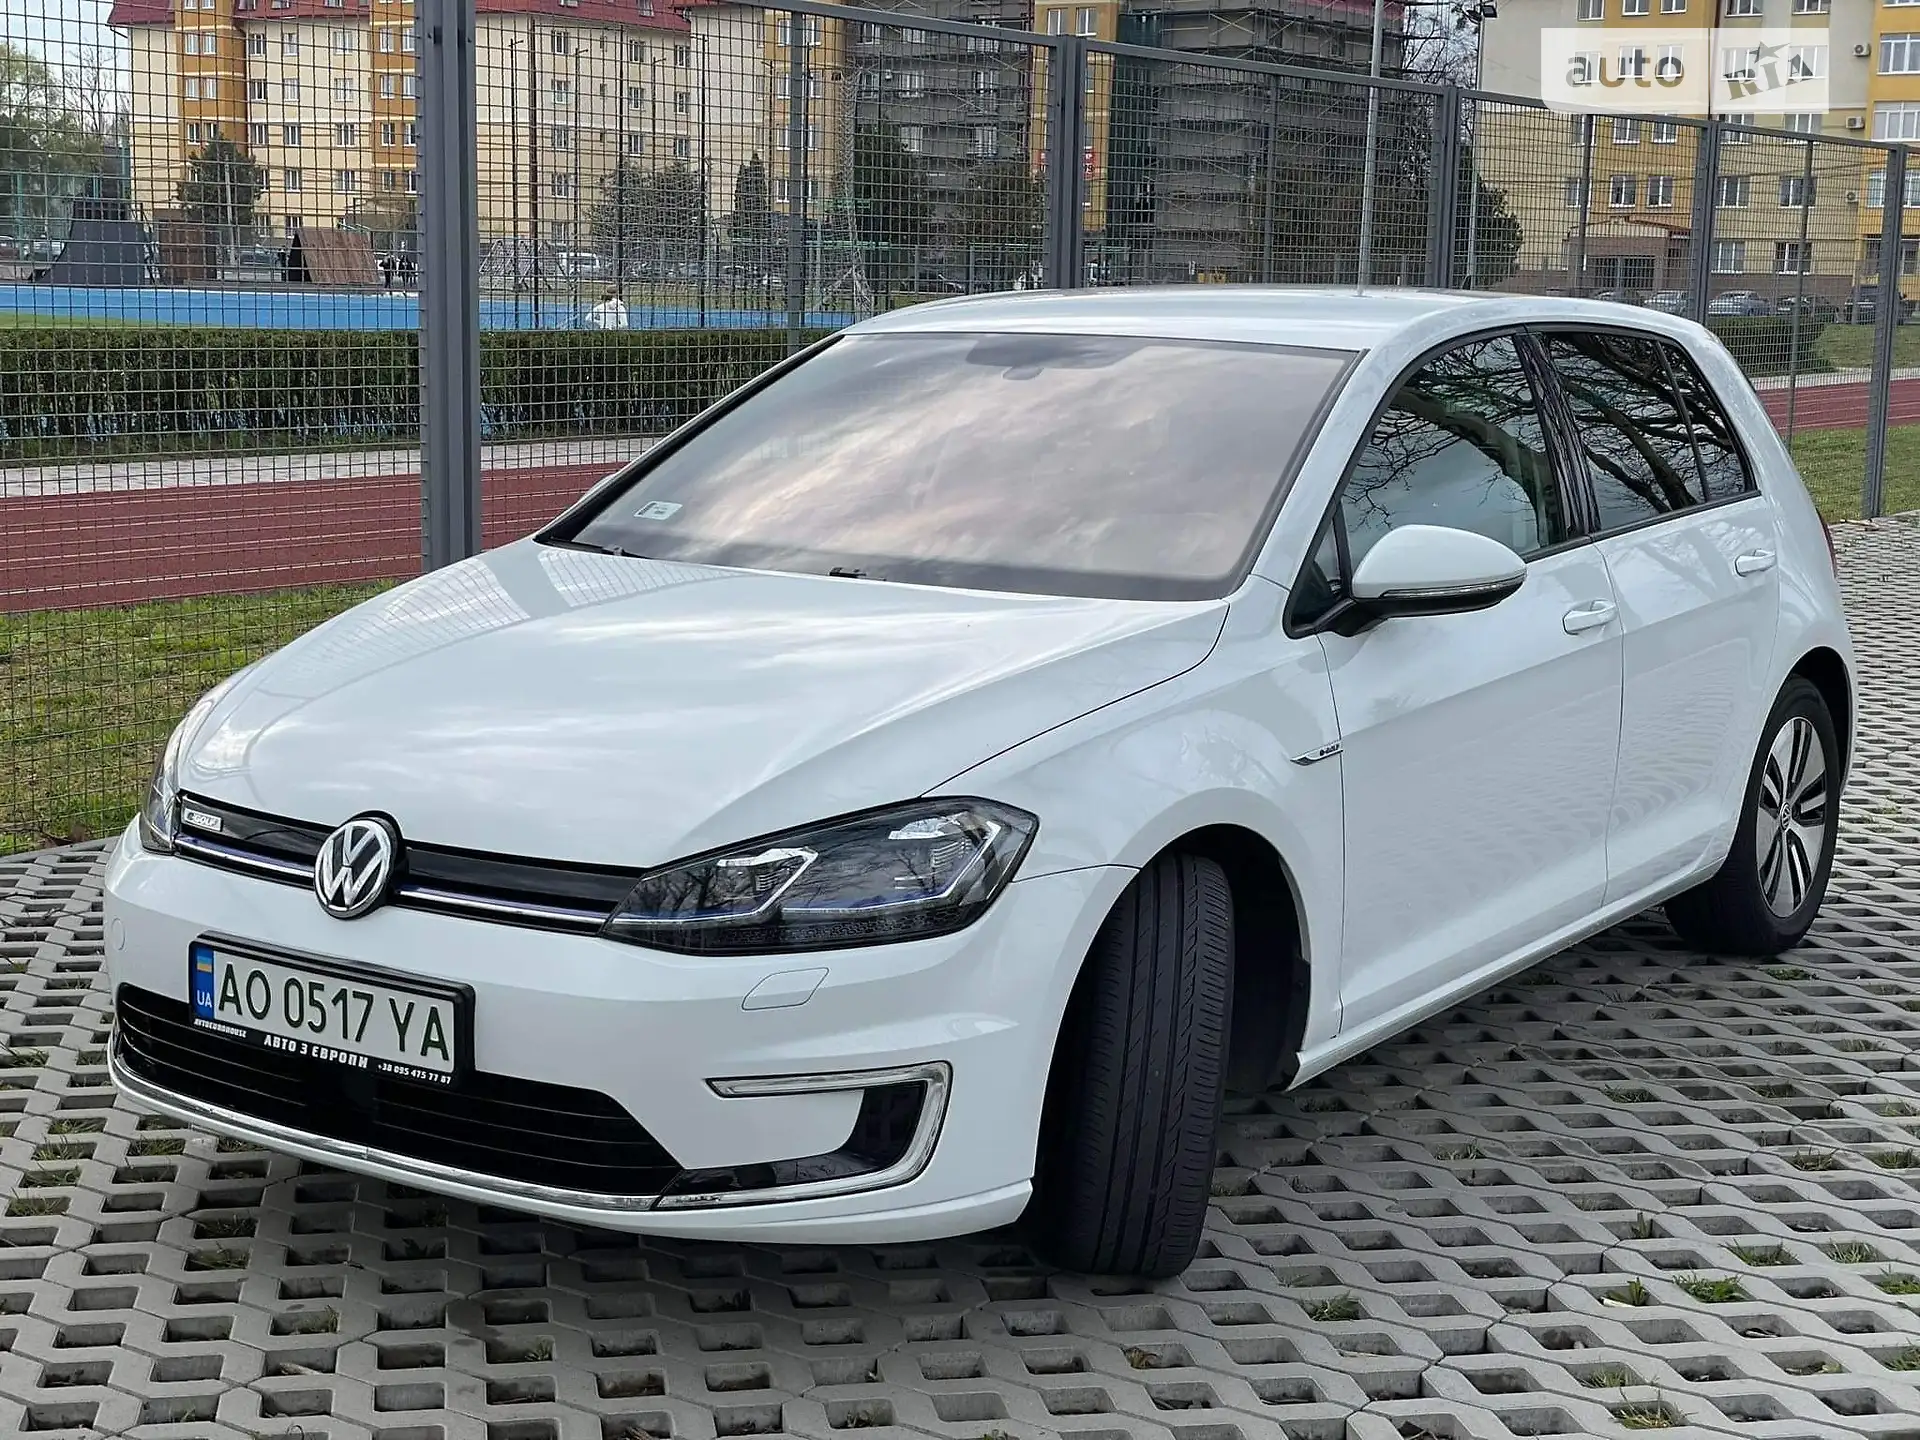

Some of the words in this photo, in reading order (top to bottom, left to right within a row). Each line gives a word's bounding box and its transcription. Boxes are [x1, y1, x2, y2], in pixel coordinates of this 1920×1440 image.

[196, 989, 212, 1008] UA
[219, 963, 271, 1020] AO
[283, 977, 374, 1042] 0517
[388, 998, 450, 1061] YA
